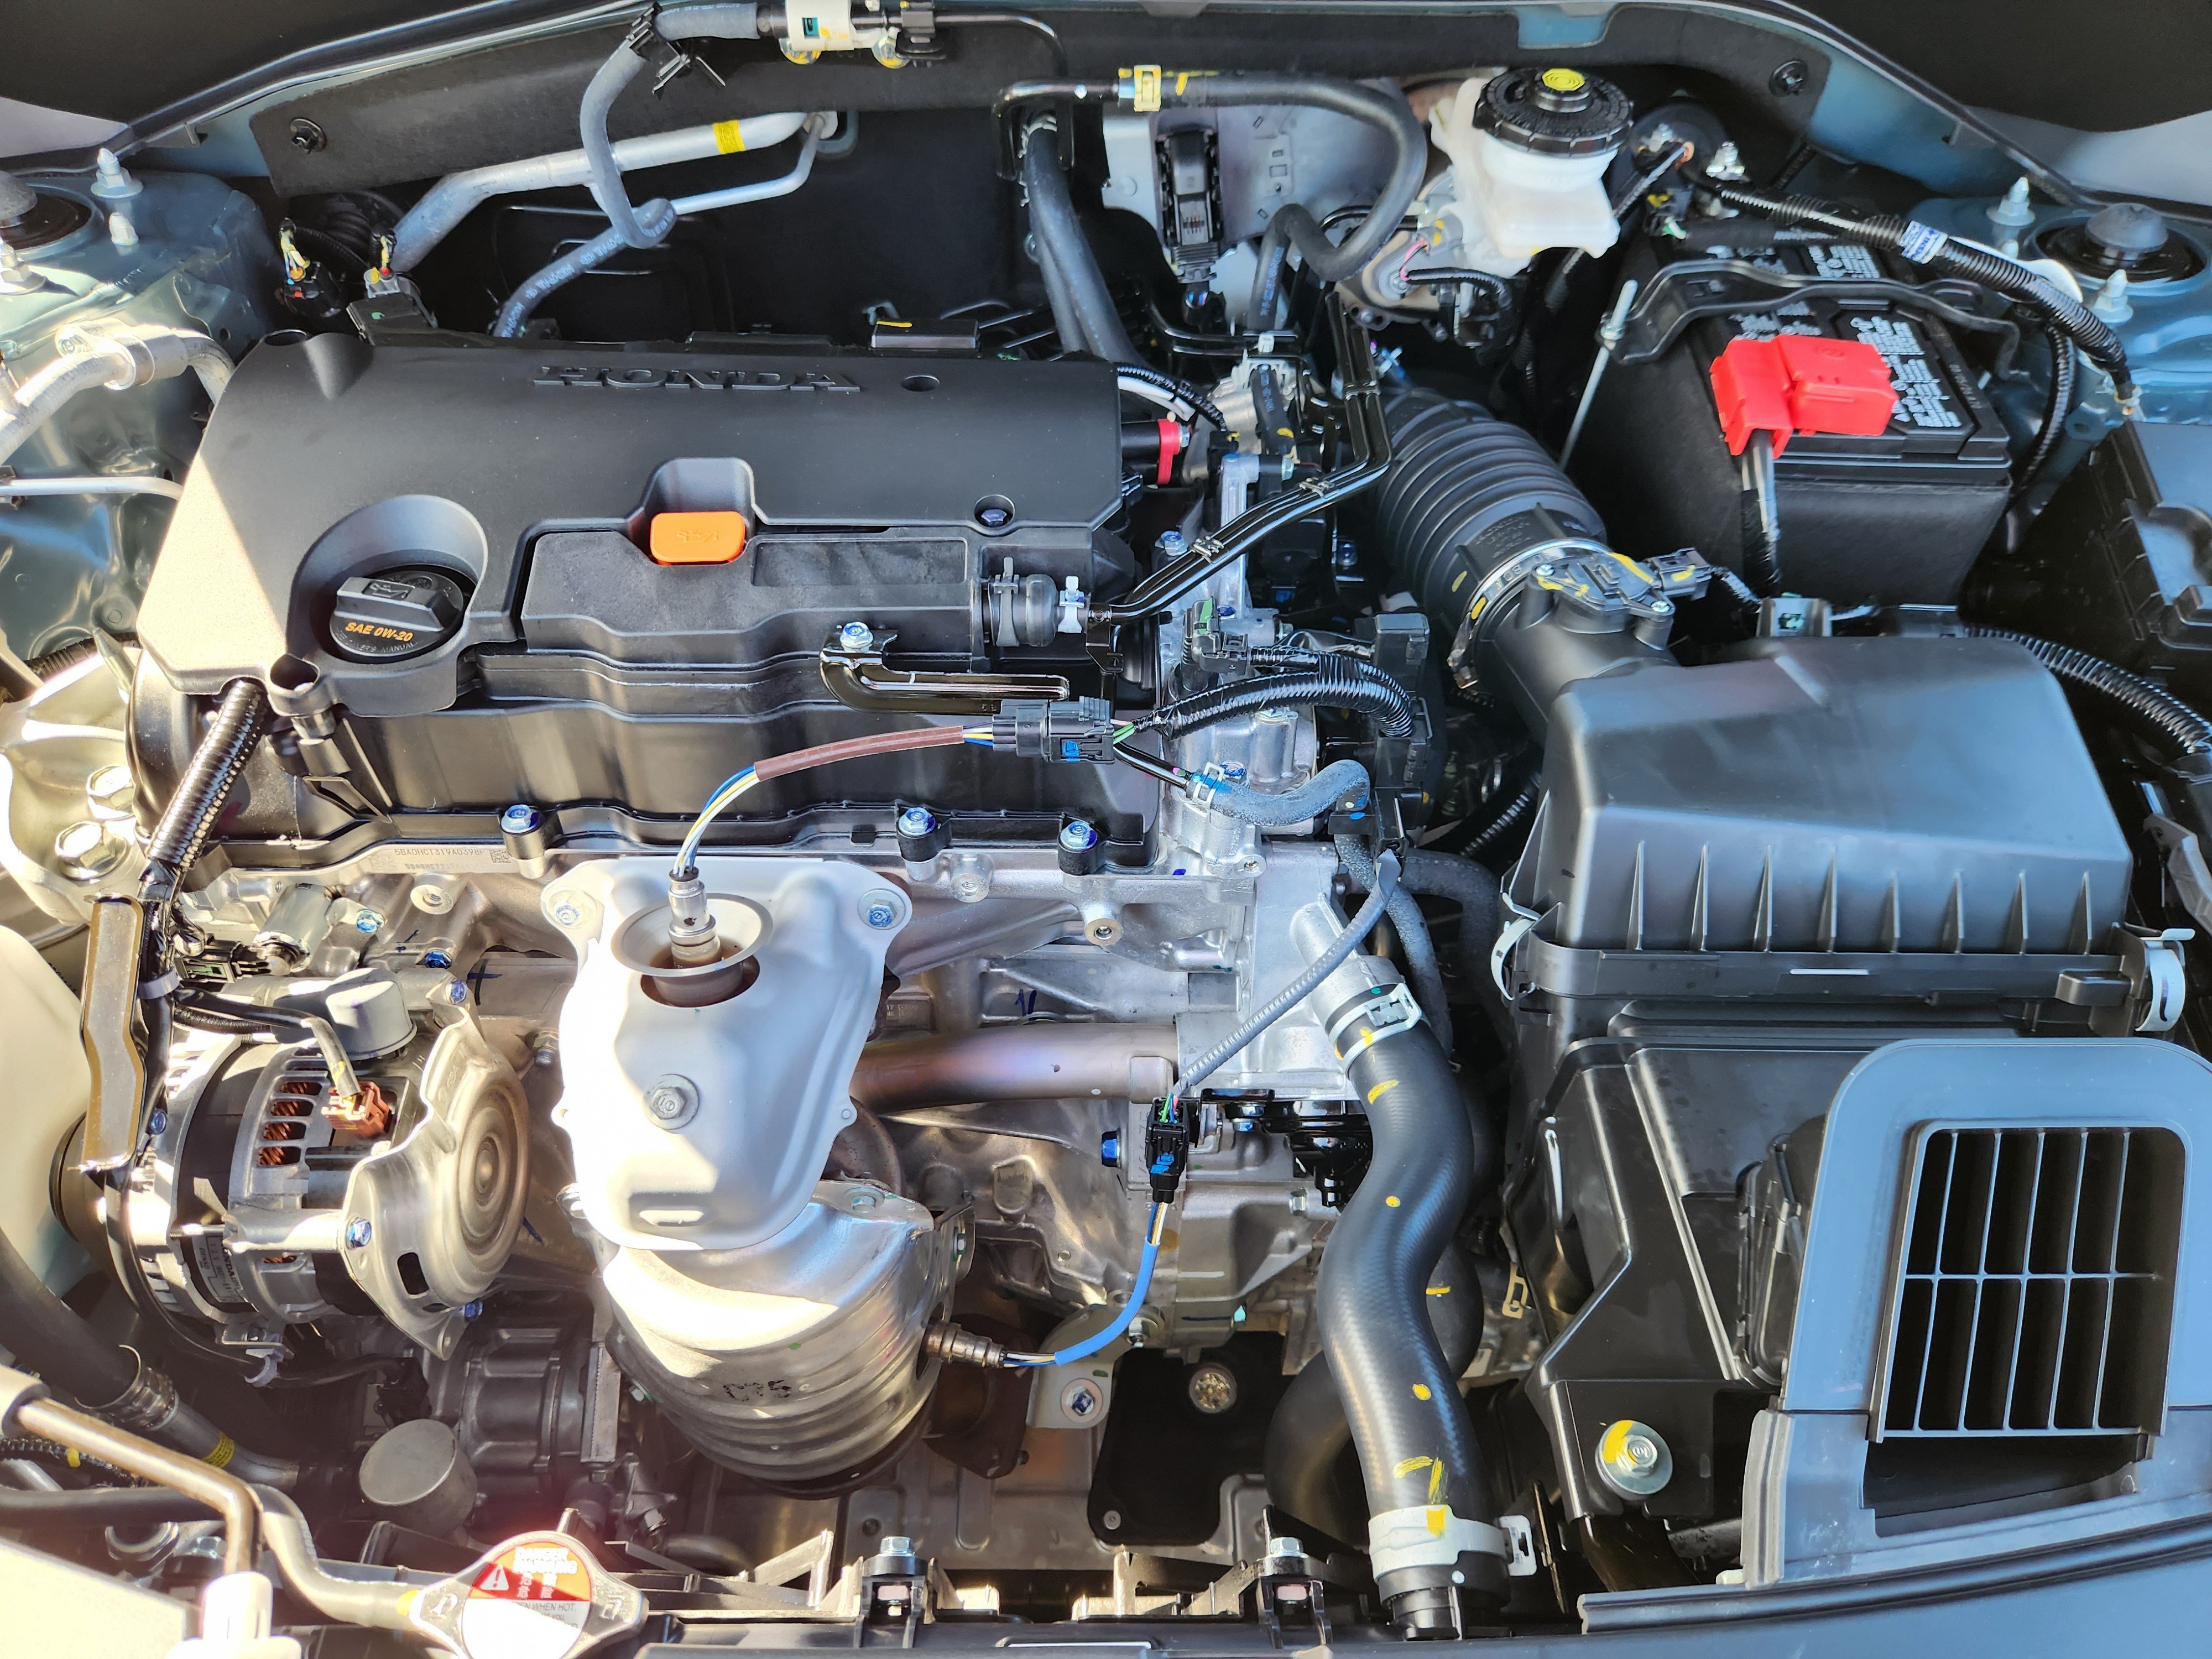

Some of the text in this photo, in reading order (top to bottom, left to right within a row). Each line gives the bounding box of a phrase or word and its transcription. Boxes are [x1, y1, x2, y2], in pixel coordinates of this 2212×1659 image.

[533, 366, 860, 392] HONDA
[345, 622, 414, 642] SAE 0W-20
[532, 1603, 556, 1611] WHEN
[558, 1603, 577, 1611] HOT.
